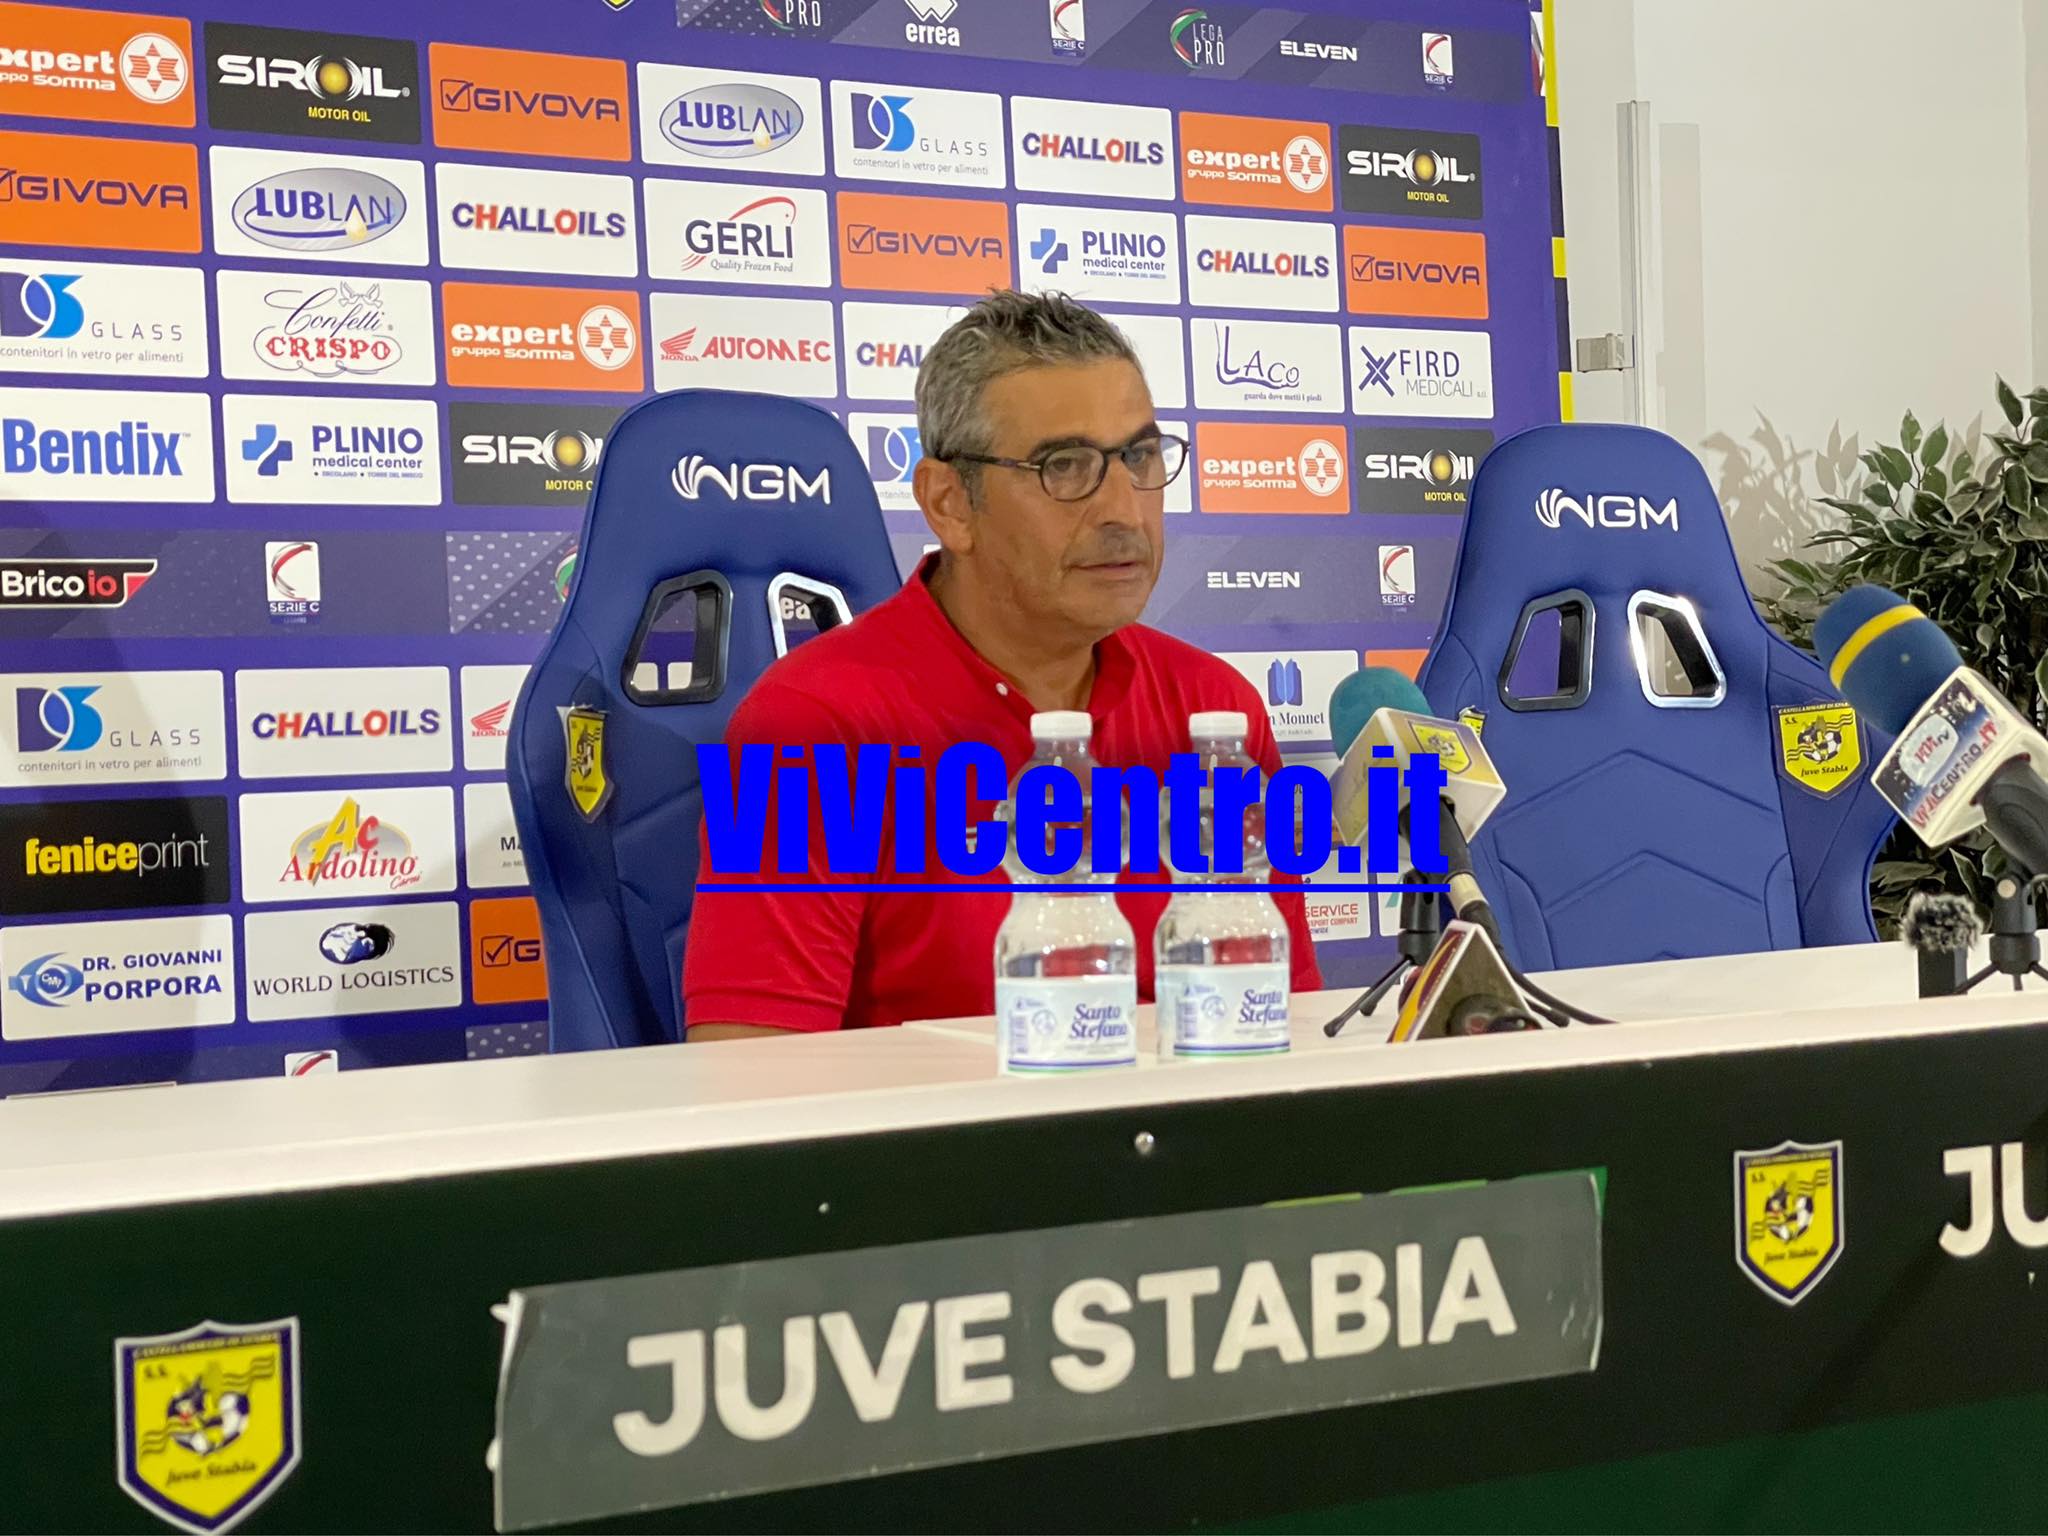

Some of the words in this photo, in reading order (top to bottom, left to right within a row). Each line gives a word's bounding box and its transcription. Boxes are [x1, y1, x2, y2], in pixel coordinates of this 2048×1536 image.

[1193, 23, 1223, 41] LEGA
[1194, 40, 1224, 65] PRO
[1280, 40, 1357, 61] ELEVEN
[33, 74, 115, 91] somma
[308, 107, 350, 121] MOTOR
[352, 109, 371, 122] OIL
[473, 87, 620, 122] GIVOVA
[678, 100, 792, 134] LUBLAN
[920, 138, 988, 156] GLASS
[1022, 132, 1164, 165] CHALLOILS
[914, 162, 935, 171] vetro
[938, 164, 951, 172] per
[1187, 149, 1281, 171] expert
[1188, 169, 1225, 181] gruppo
[1228, 172, 1281, 184] somma
[16, 176, 188, 210] GIVOVA
[1407, 191, 1434, 202] MOTOR
[1436, 193, 1449, 203] OIL
[255, 187, 392, 224] LUBLAN
[452, 202, 626, 237] CHALLOILS
[685, 220, 794, 259] GERLI
[875, 231, 1002, 259] GIVOVA
[1082, 231, 1166, 258] PLINIO
[711, 259, 742, 272] Quality
[774, 262, 793, 272] Food
[1083, 257, 1128, 269] medical
[1130, 261, 1166, 271] center
[1197, 249, 1329, 278] CHALLOILS
[1375, 260, 1480, 285] GIVOVA
[91, 322, 183, 341] GLASS
[451, 322, 575, 347] expert
[67, 348, 77, 358] in
[82, 350, 111, 360] vetro
[116, 351, 133, 363] per
[138, 350, 183, 362] alimenti
[266, 336, 390, 362] CRISPO
[451, 345, 501, 358] gruppo
[504, 347, 575, 362] somma
[702, 335, 832, 364] AUTOMEC
[1399, 349, 1459, 378] FIRD
[1406, 379, 1472, 397] MEDICALI
[2, 418, 184, 476] Bendix
[312, 425, 423, 454] PLINIO
[313, 455, 372, 467] medical
[376, 458, 422, 468] center
[1203, 457, 1297, 476] expert
[545, 480, 582, 491] MOTOR
[671, 455, 832, 505] NGM
[1203, 478, 1240, 489] gruppo
[1243, 479, 1297, 489] somma
[1424, 492, 1451, 501] MOTOR
[1454, 492, 1466, 501] OIL
[1536, 488, 1678, 531] NGM
[1207, 571, 1300, 588] ELEVEN
[270, 602, 306, 612] SERIE
[310, 602, 319, 612] C
[1382, 595, 1406, 603] SERIE
[1408, 595, 1415, 603] C
[252, 709, 440, 739] CHALLOILS
[1280, 712, 1324, 724] Monnet
[110, 729, 200, 747] GLASS
[18, 760, 81, 772] contenitori
[85, 759, 95, 769] in
[100, 759, 129, 769] vetro
[134, 759, 152, 771] per
[156, 756, 201, 768] alimenti
[25, 834, 209, 877] feniceprint
[280, 850, 416, 882] Ardolino
[83, 957, 115, 972] DR.
[123, 949, 222, 969] GIOVANNI
[85, 975, 221, 1002] PORPORA
[254, 976, 333, 997] WORLD
[341, 966, 454, 991] LOGISTICS
[1244, 989, 1282, 1004] Santo
[1075, 1003, 1120, 1020] Santo
[1069, 1020, 1127, 1041] Stefano
[613, 1290, 1012, 1457] JUVE
[1050, 1235, 1518, 1395] STABIA
